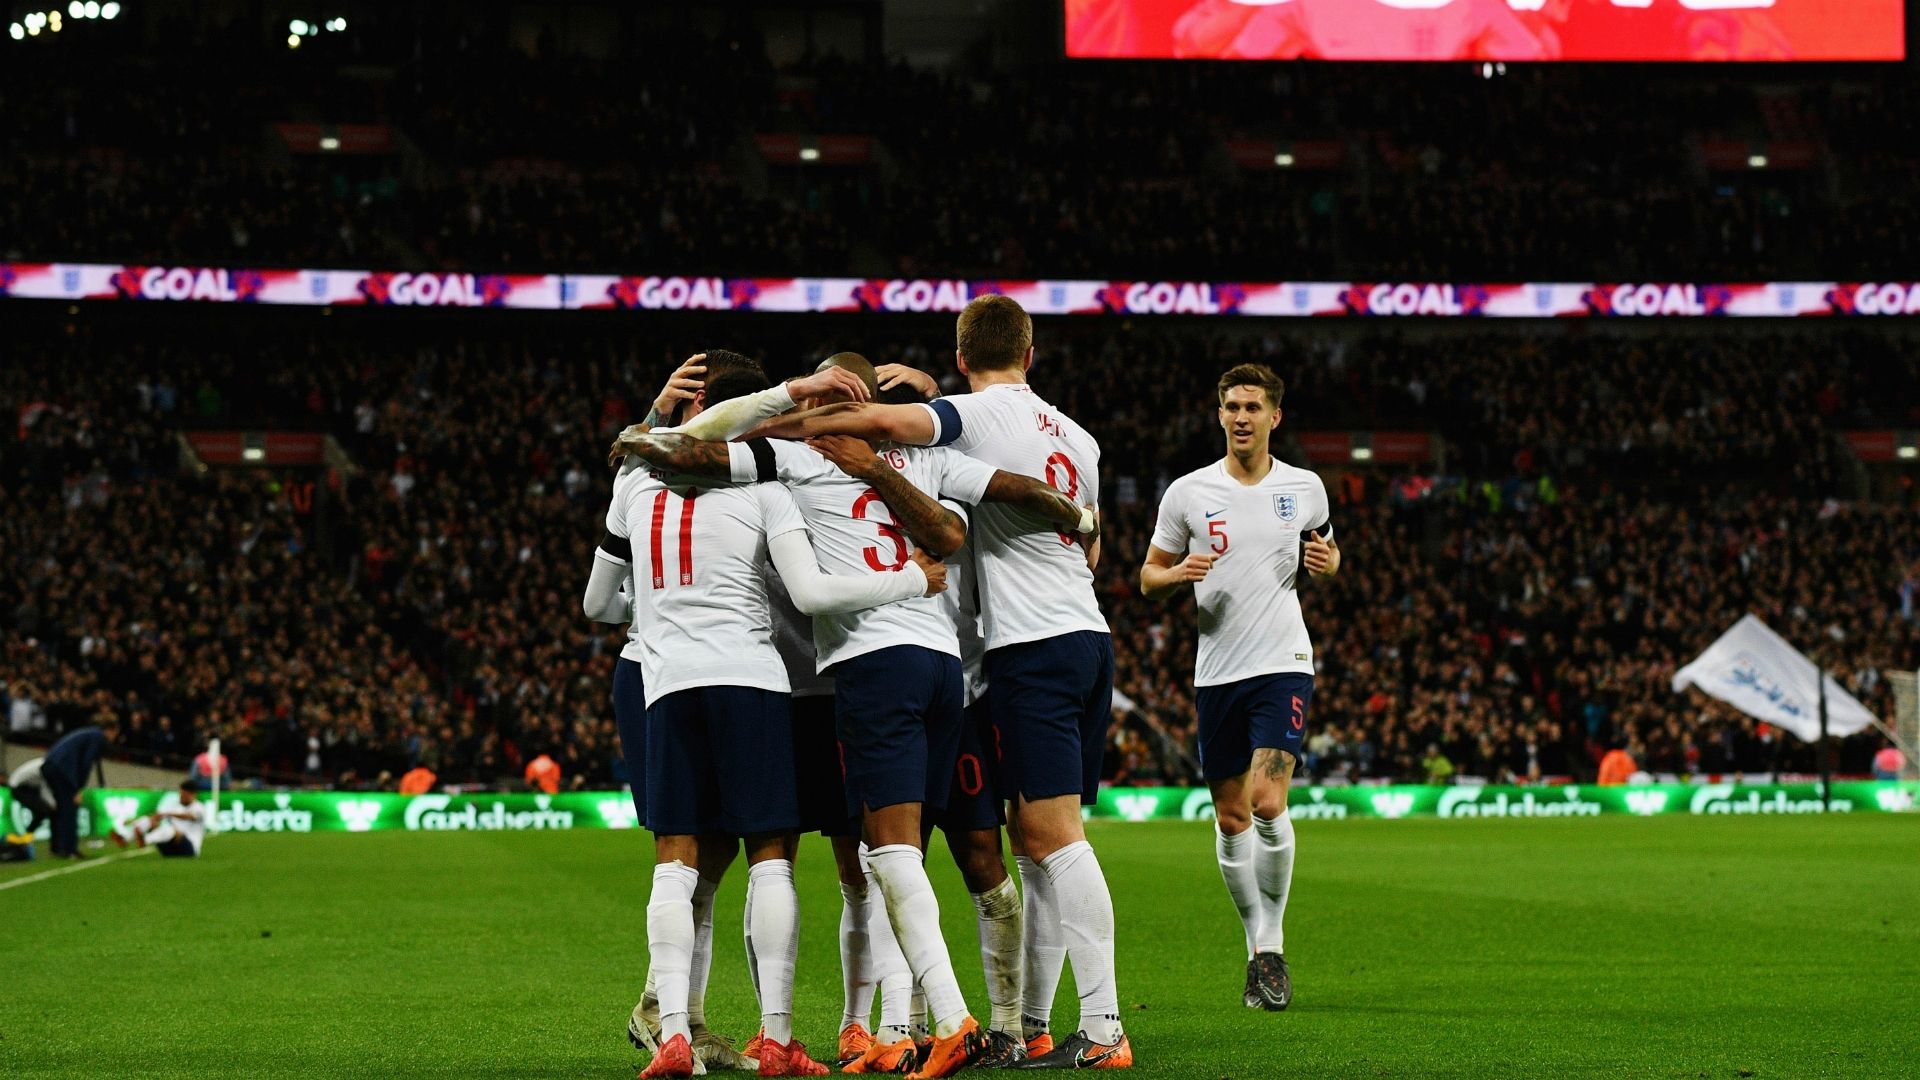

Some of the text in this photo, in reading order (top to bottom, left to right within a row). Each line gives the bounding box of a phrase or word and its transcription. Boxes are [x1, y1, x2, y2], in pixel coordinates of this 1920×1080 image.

[141, 266, 236, 301] GOAL
[388, 272, 484, 306] GOAL
[637, 276, 731, 309] GOAL
[1125, 281, 1220, 315] GOAL
[1368, 282, 1463, 315] GOAL
[1611, 282, 1705, 316] GOAL
[1853, 282, 1920, 315] GOA
[651, 486, 698, 590] 11
[852, 487, 910, 573] 3
[1208, 520, 1229, 555] 5
[1291, 695, 1304, 730] 5
